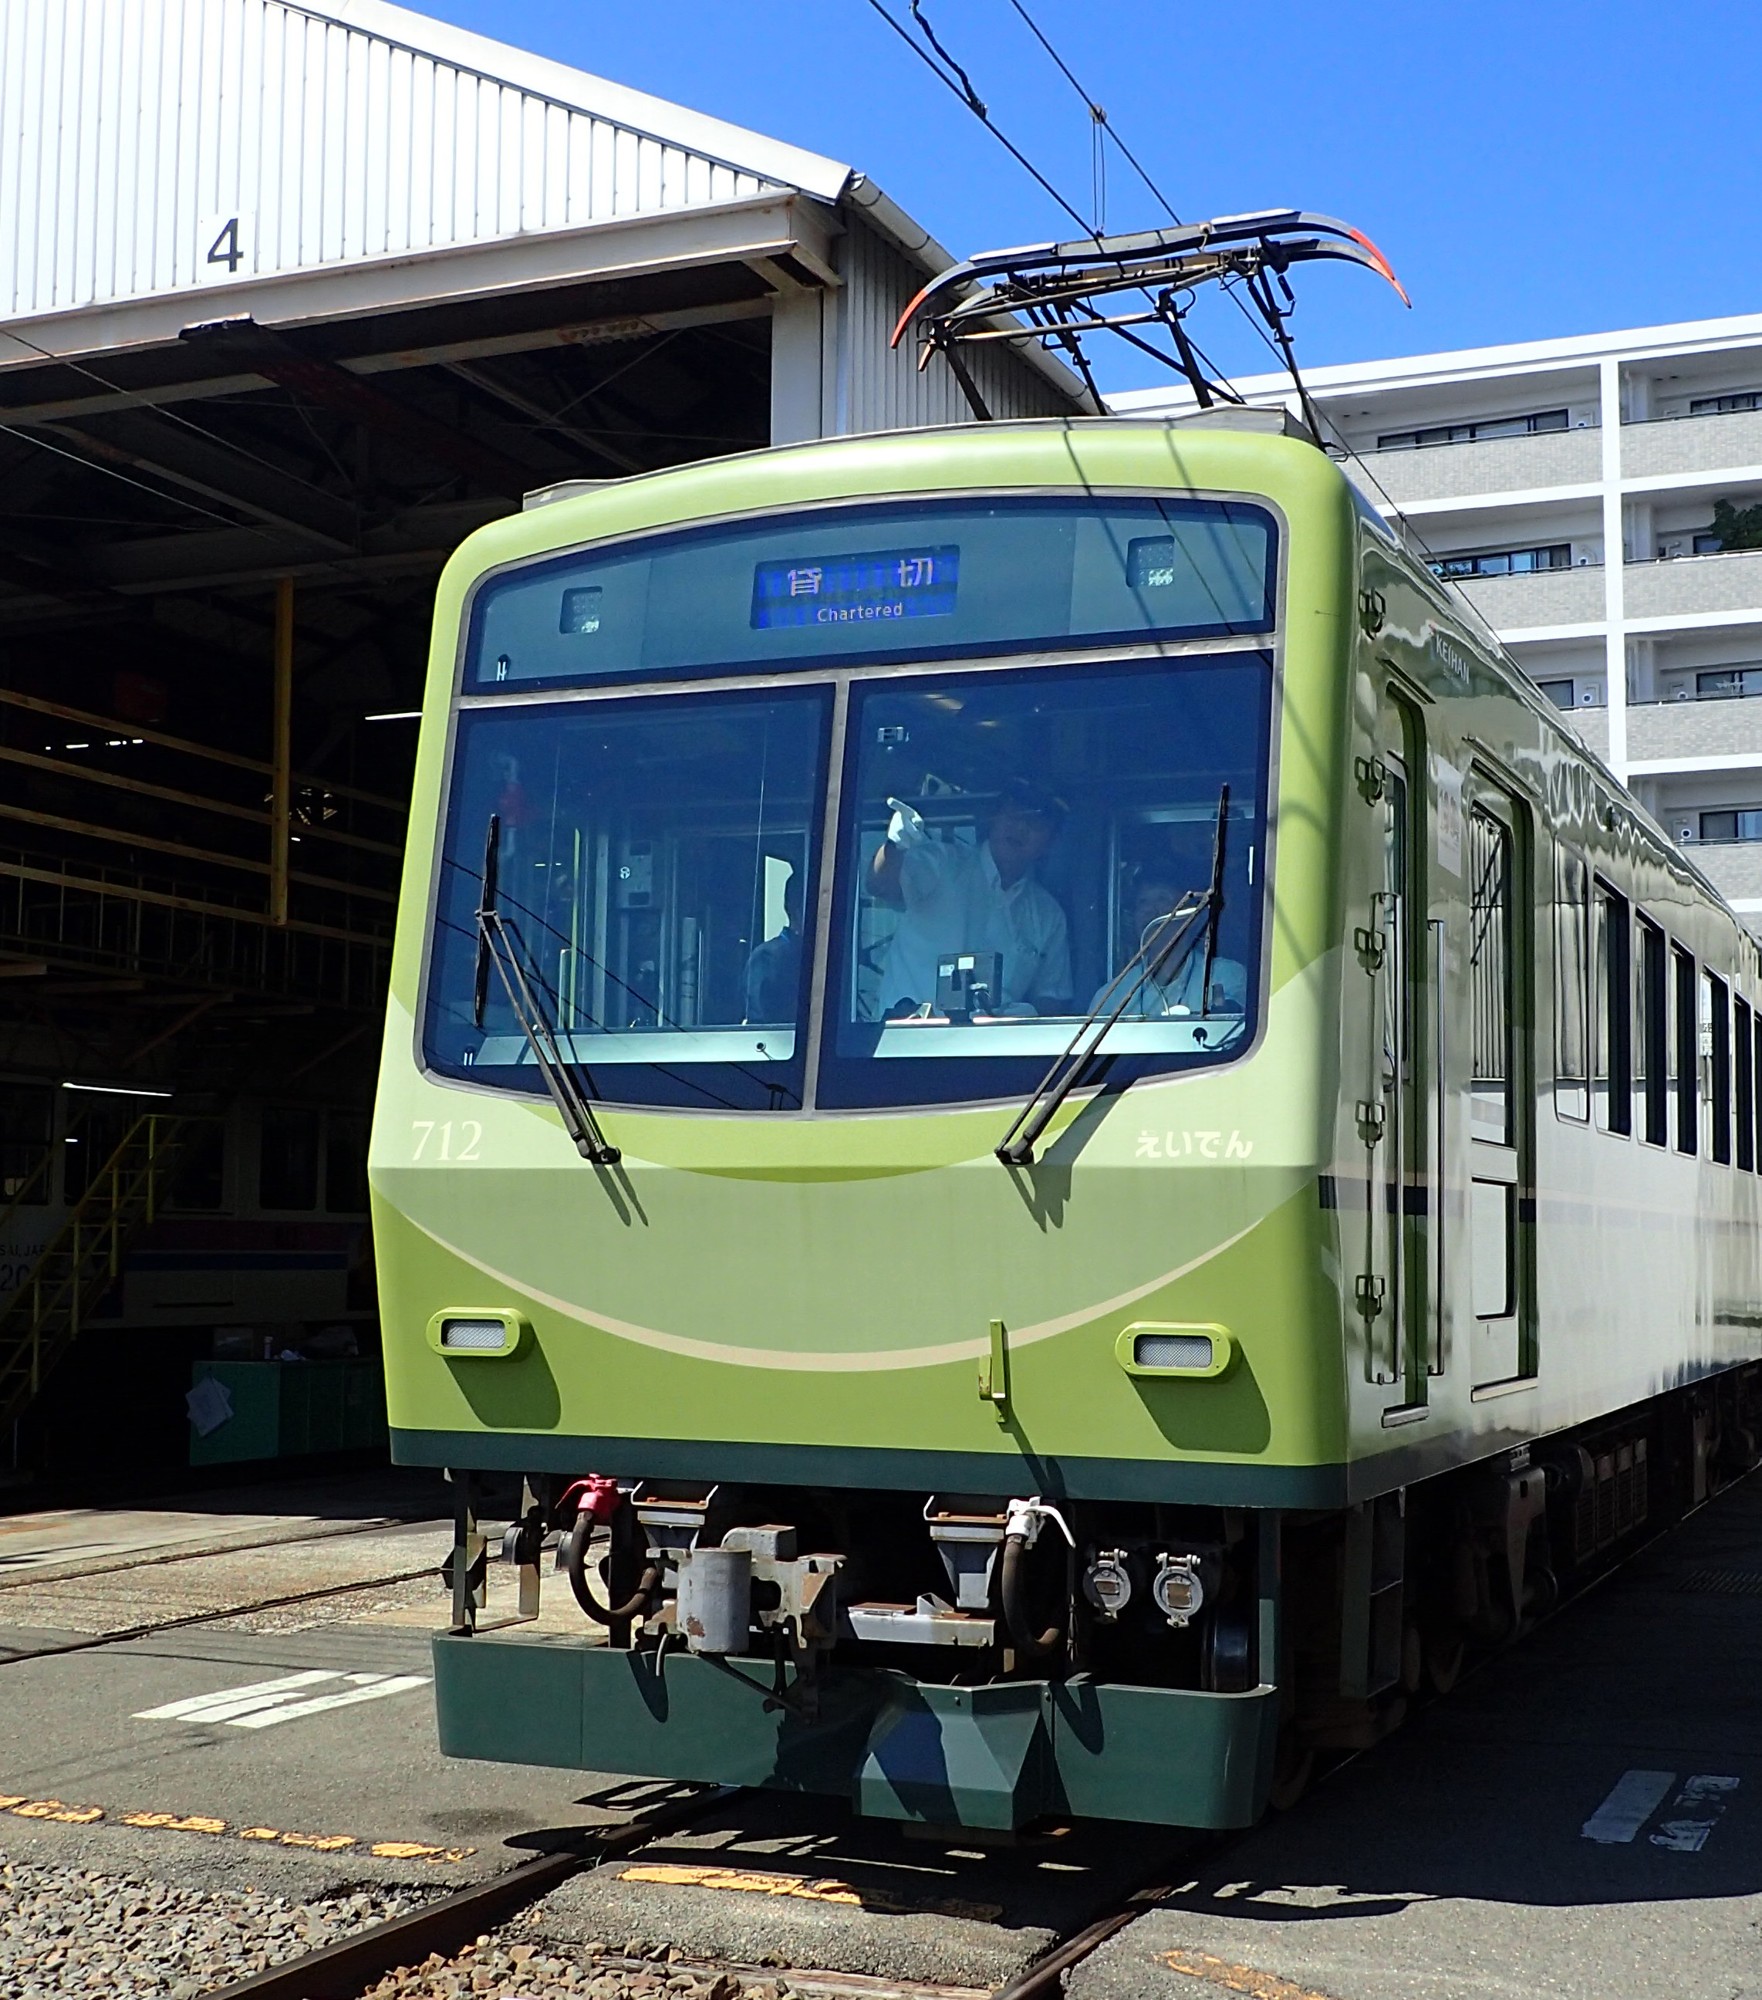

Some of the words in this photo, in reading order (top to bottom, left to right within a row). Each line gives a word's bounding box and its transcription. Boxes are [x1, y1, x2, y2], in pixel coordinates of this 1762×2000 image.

[207, 218, 244, 273] 4
[816, 602, 904, 623] Chartered
[1436, 634, 1470, 685] KEIHAN
[412, 1120, 483, 1161] 712
[1135, 1130, 1254, 1159] えいでん
